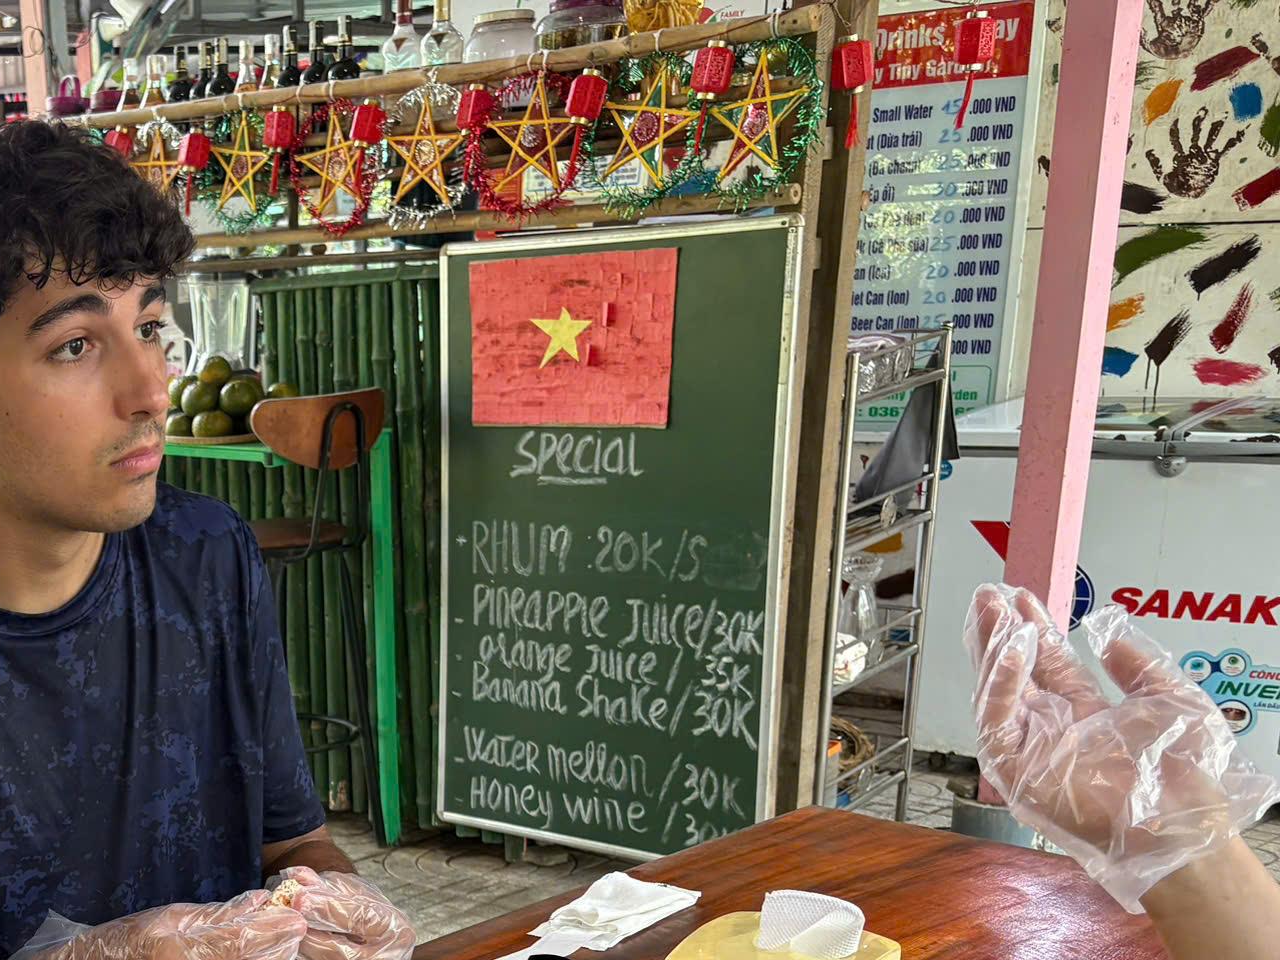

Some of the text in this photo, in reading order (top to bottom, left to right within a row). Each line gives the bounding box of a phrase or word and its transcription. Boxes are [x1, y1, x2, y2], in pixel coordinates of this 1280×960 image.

[872, 107, 902, 123] Small
[904, 104, 933, 121] Water
[969, 98, 992, 115] .000
[995, 95, 1016, 112] VND
[967, 125, 990, 142] .000
[992, 123, 1014, 140] VND
[986, 178, 1009, 195] VND
[959, 207, 982, 224] .000
[984, 206, 1006, 222] VND
[957, 234, 980, 251] .000
[982, 232, 1003, 249] VND
[926, 264, 949, 280] 20
[954, 261, 977, 278] .000
[979, 259, 1000, 275] VND
[866, 290, 884, 305] Can
[887, 289, 910, 306] (lon)
[923, 290, 947, 305] 20
[951, 288, 974, 304] .000
[976, 286, 997, 303] VND
[851, 316, 873, 331] Beer
[876, 315, 894, 330] Can
[974, 313, 994, 329] VND
[971, 339, 992, 355] VND
[472, 660, 568, 715] Banana
